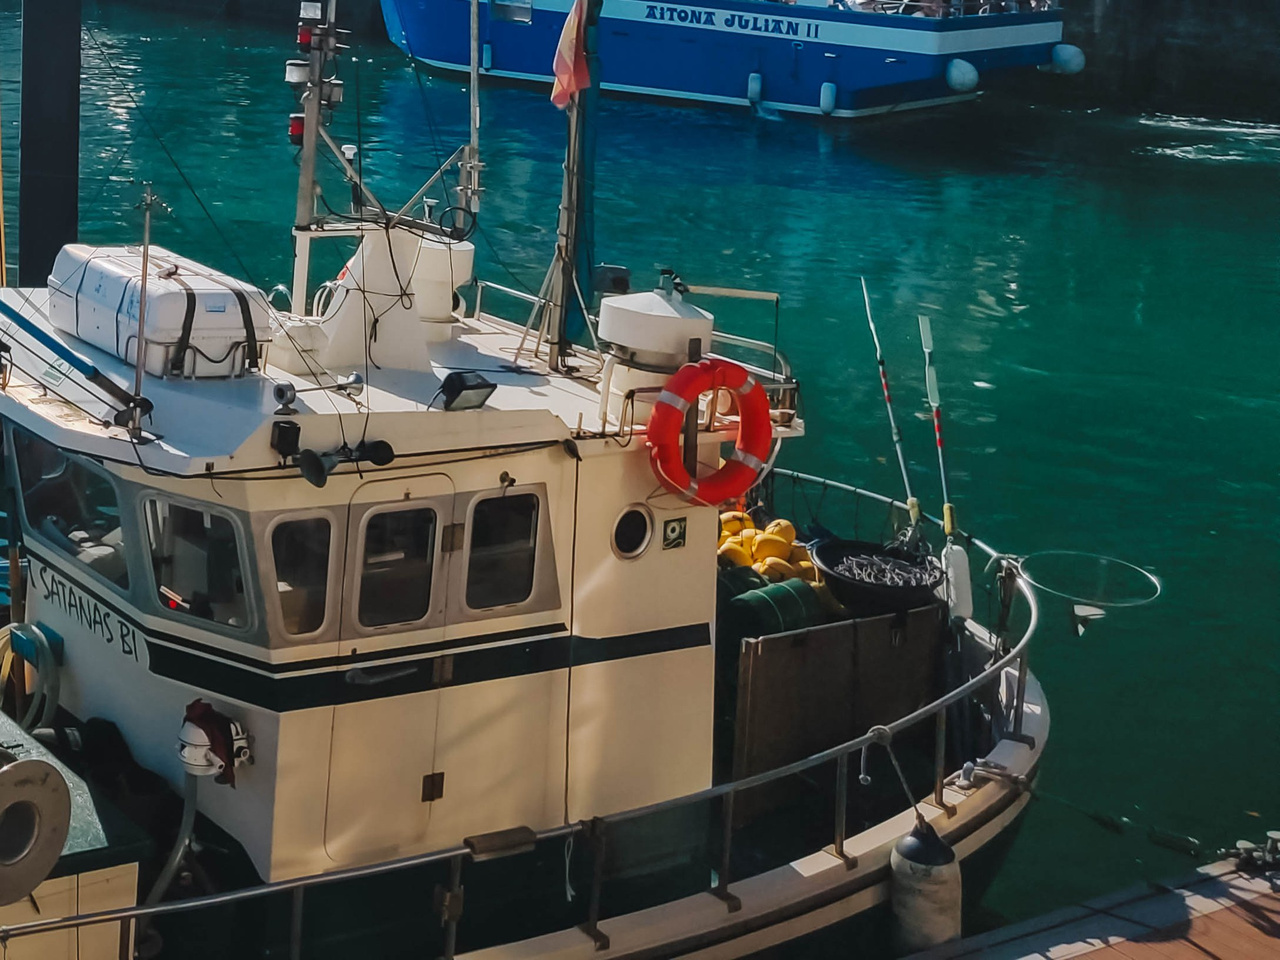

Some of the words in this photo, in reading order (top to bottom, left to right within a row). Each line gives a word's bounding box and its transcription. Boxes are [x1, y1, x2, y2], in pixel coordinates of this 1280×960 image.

[806, 23, 819, 38] II
[39, 565, 113, 644] SATANAS
[117, 619, 139, 662] BI
